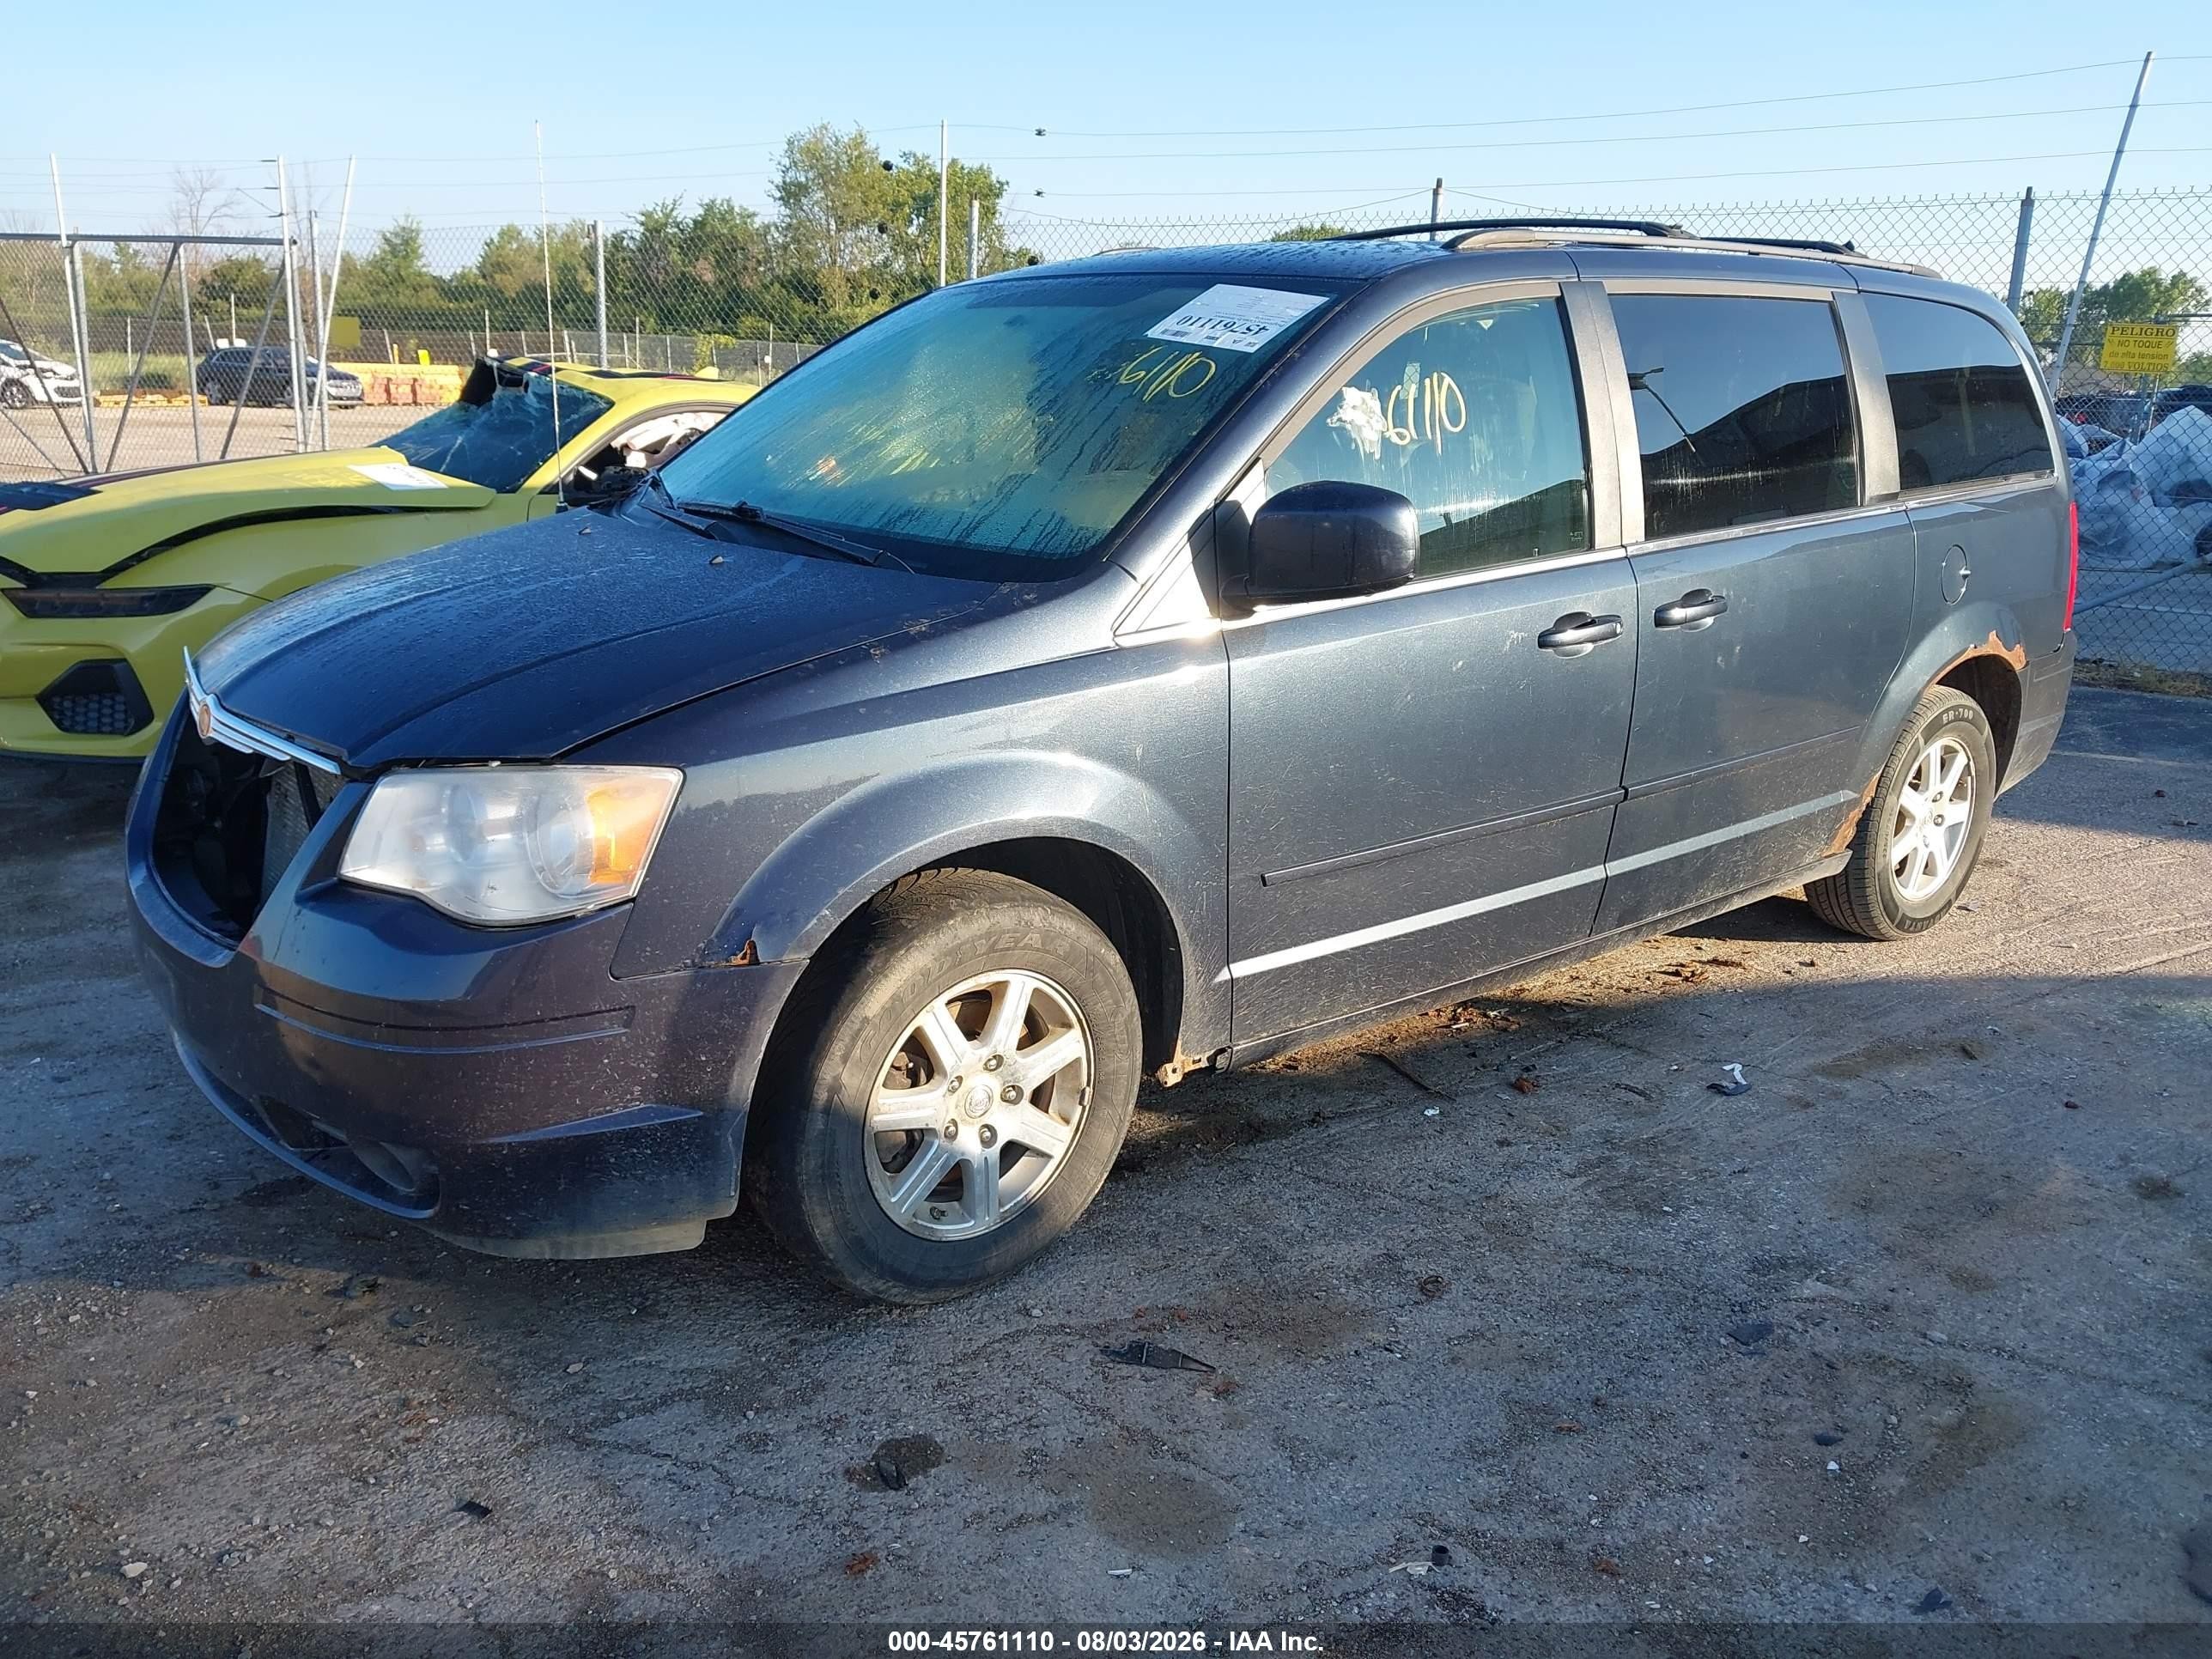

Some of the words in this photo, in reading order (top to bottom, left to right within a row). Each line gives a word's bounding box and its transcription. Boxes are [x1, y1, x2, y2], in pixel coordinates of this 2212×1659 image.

[1176, 314, 1270, 337] 45761110
[2111, 326, 2176, 337] PELIGRO
[2117, 339, 2130, 348] NO
[2133, 340, 2163, 349] TOQUE
[2138, 351, 2169, 360] tension
[2128, 361, 2169, 372] VOLTIOS
